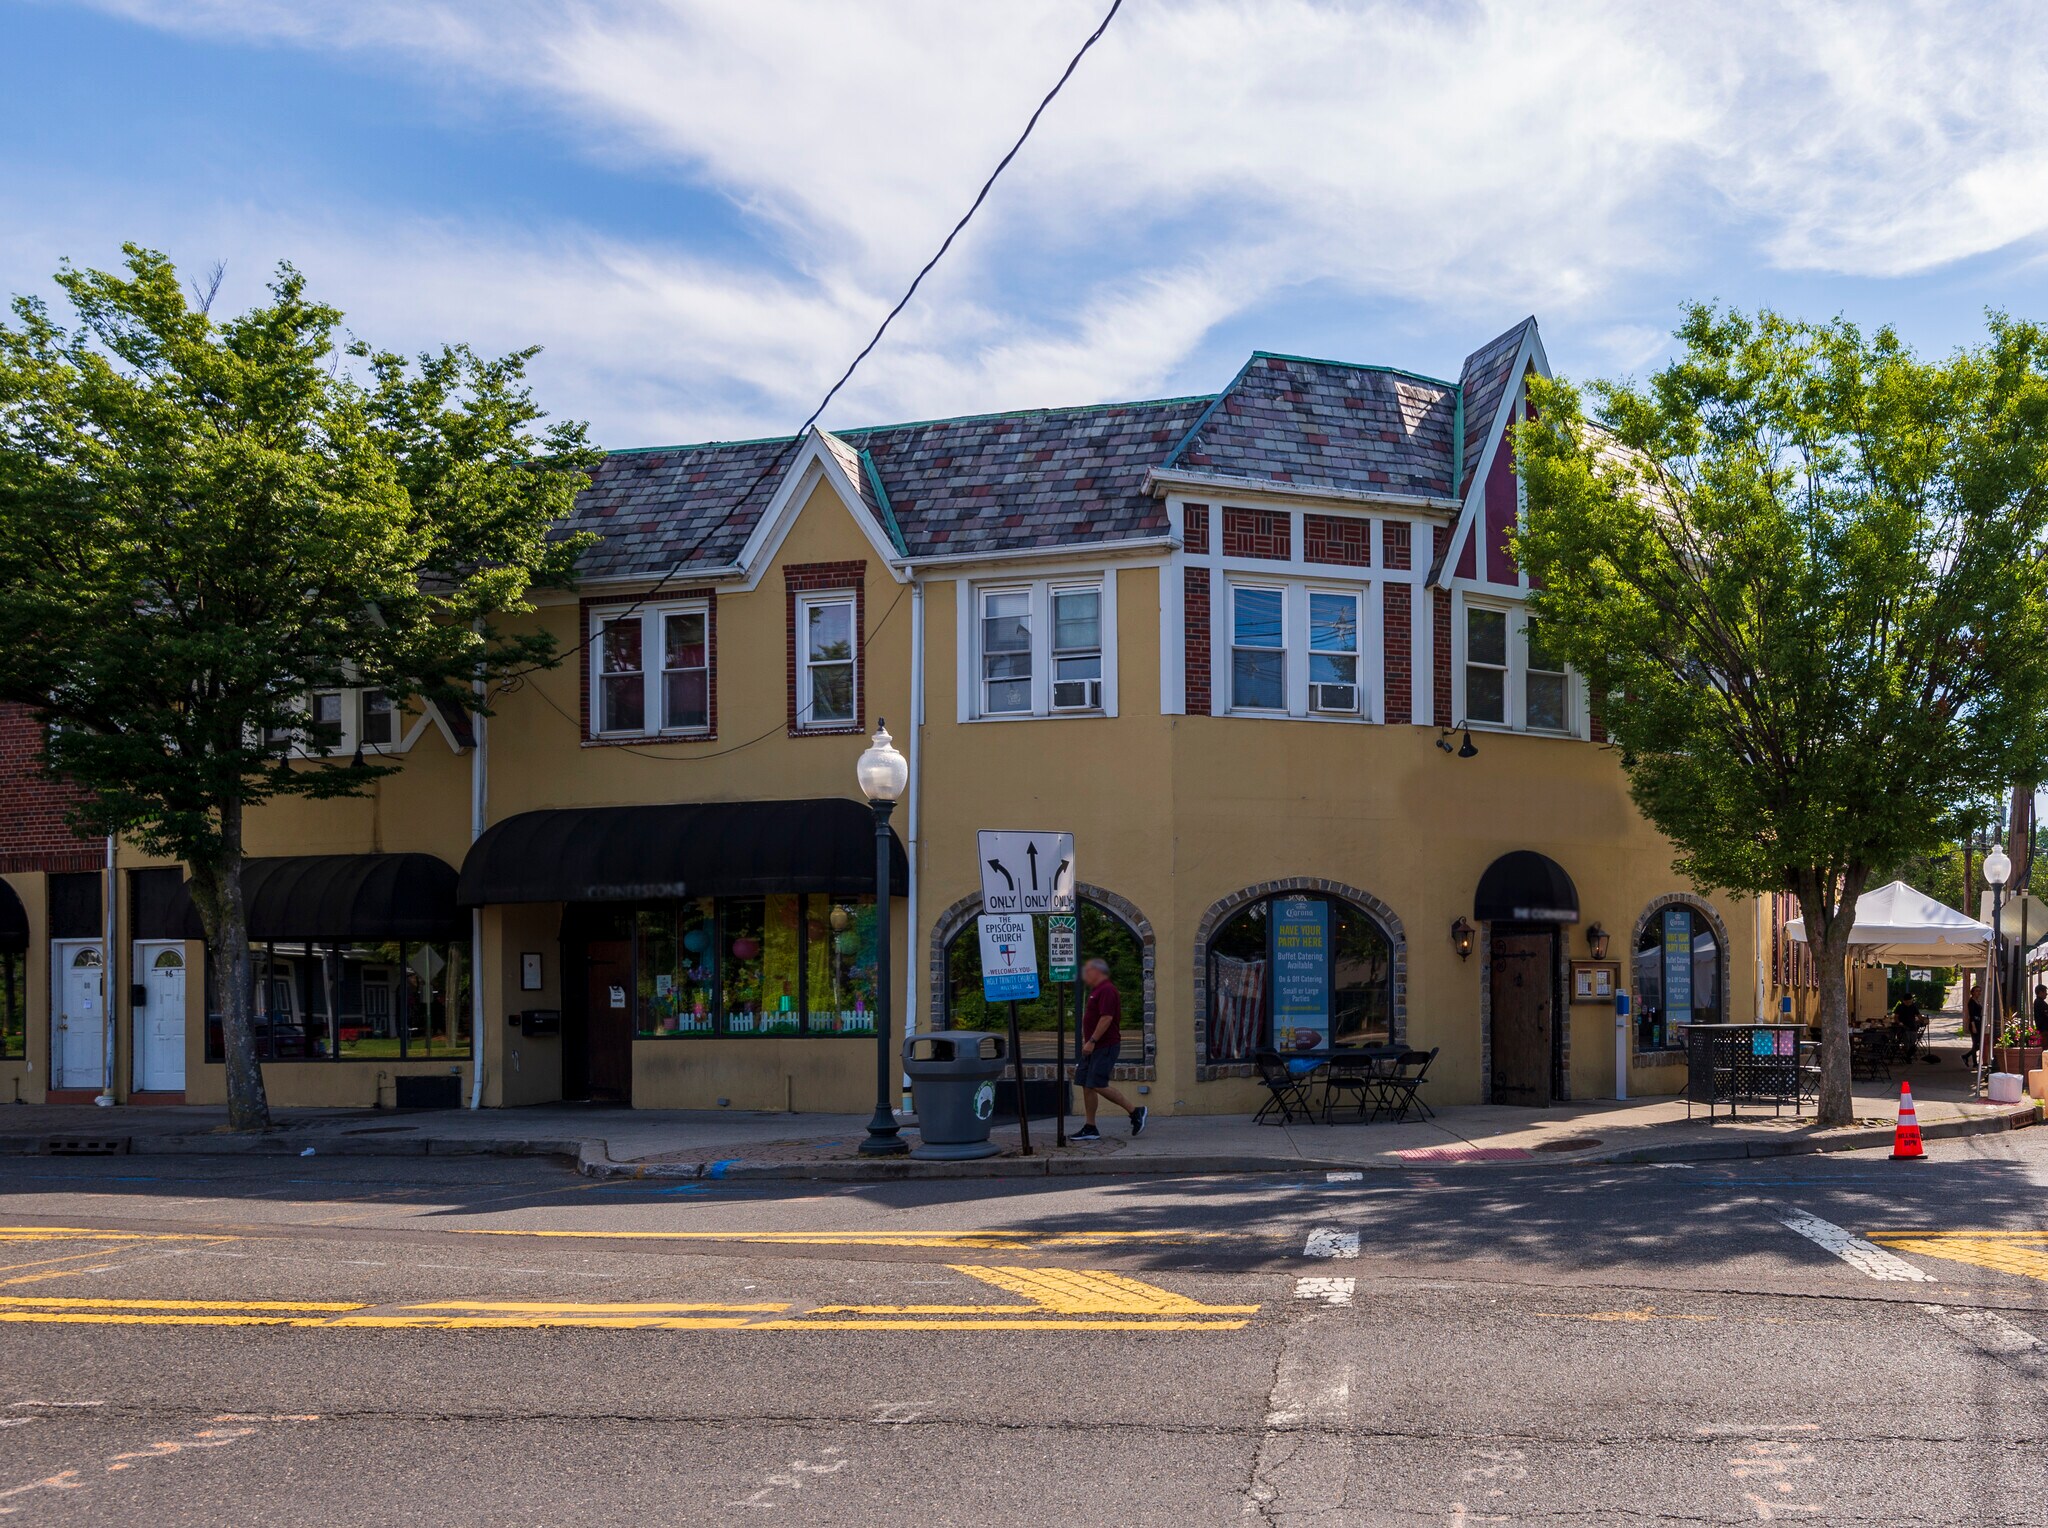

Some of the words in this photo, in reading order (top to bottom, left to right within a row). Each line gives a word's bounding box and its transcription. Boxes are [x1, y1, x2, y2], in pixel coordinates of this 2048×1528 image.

[990, 896, 1016, 908] ONLY
[1025, 895, 1048, 907] ONLY
[1054, 895, 1072, 907] ONLY
[1286, 909, 1313, 918] Corona
[986, 923, 1026, 933] EPISCOPAL
[1280, 925, 1298, 935] HAVE
[1301, 925, 1321, 935] YOUR
[992, 933, 1022, 943] CHURCH
[1278, 937, 1300, 947] PARTY
[1303, 937, 1322, 947] HERE
[1278, 952, 1296, 961] Buffet
[1298, 952, 1323, 962] Catering
[1287, 961, 1313, 969] Available
[986, 977, 998, 985] HOLY
[1000, 976, 1016, 984] TRINITY
[1018, 975, 1035, 983] CHURCH
[1301, 976, 1322, 984] Catering
[1305, 988, 1319, 996] Large
